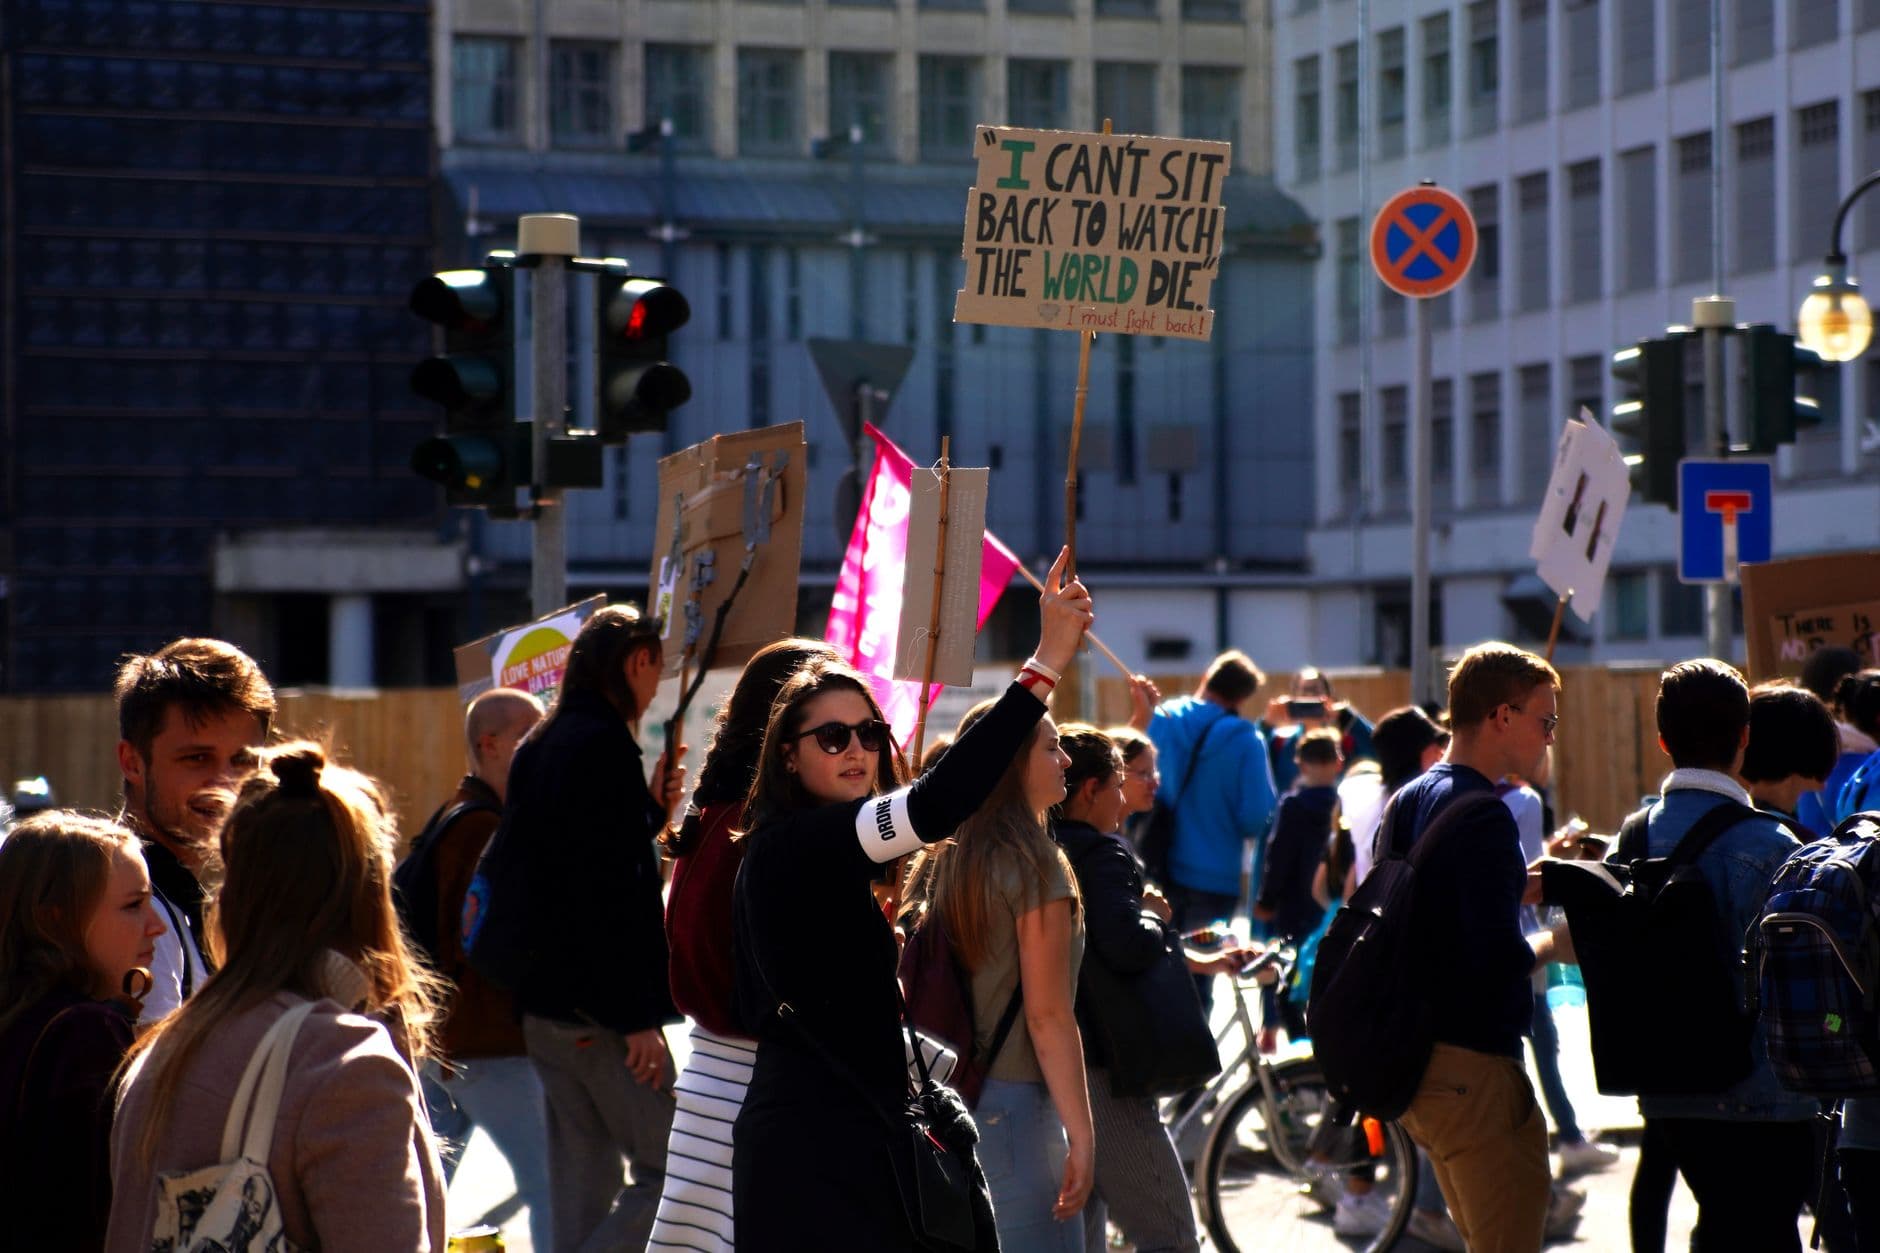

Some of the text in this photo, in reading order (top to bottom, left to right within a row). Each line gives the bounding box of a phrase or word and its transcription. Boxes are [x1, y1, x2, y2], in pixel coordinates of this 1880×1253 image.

[1045, 141, 1150, 197] CAN'T
[1155, 150, 1224, 202] SIT
[976, 192, 1218, 254] BACK TO WATCH
[975, 247, 1031, 297] THE
[1043, 250, 1139, 304] WORLD
[1066, 305, 1204, 336] I must fight back!
[503, 645, 569, 685] LOVE NATUR
[528, 671, 557, 694] HATE
[876, 797, 896, 841] ORDNE
